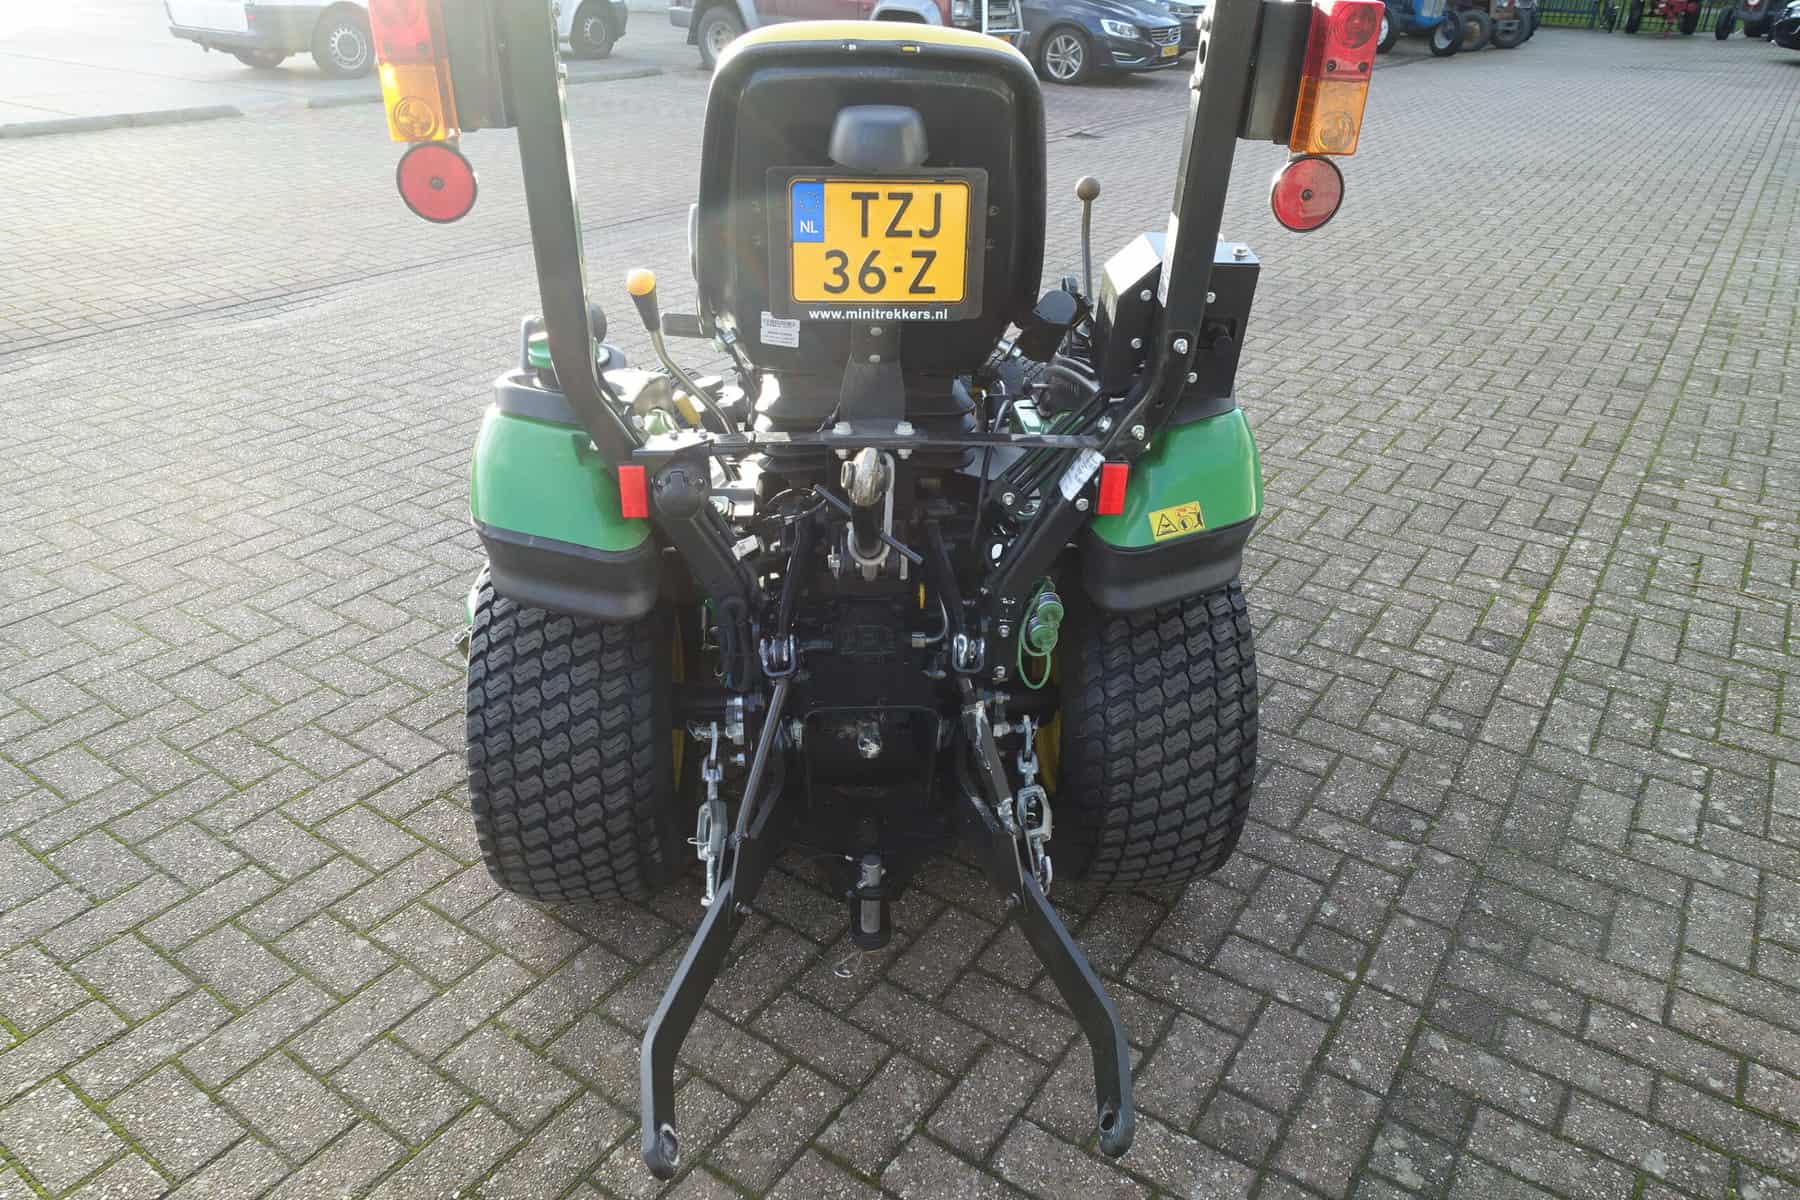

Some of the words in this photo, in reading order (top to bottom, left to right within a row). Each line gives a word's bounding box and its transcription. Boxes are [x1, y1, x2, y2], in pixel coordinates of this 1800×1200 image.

[800, 220, 819, 233] NL
[851, 192, 942, 238] TZJ
[823, 250, 937, 294] 36-Z
[808, 308, 948, 320] www.minitrekkers.nl
